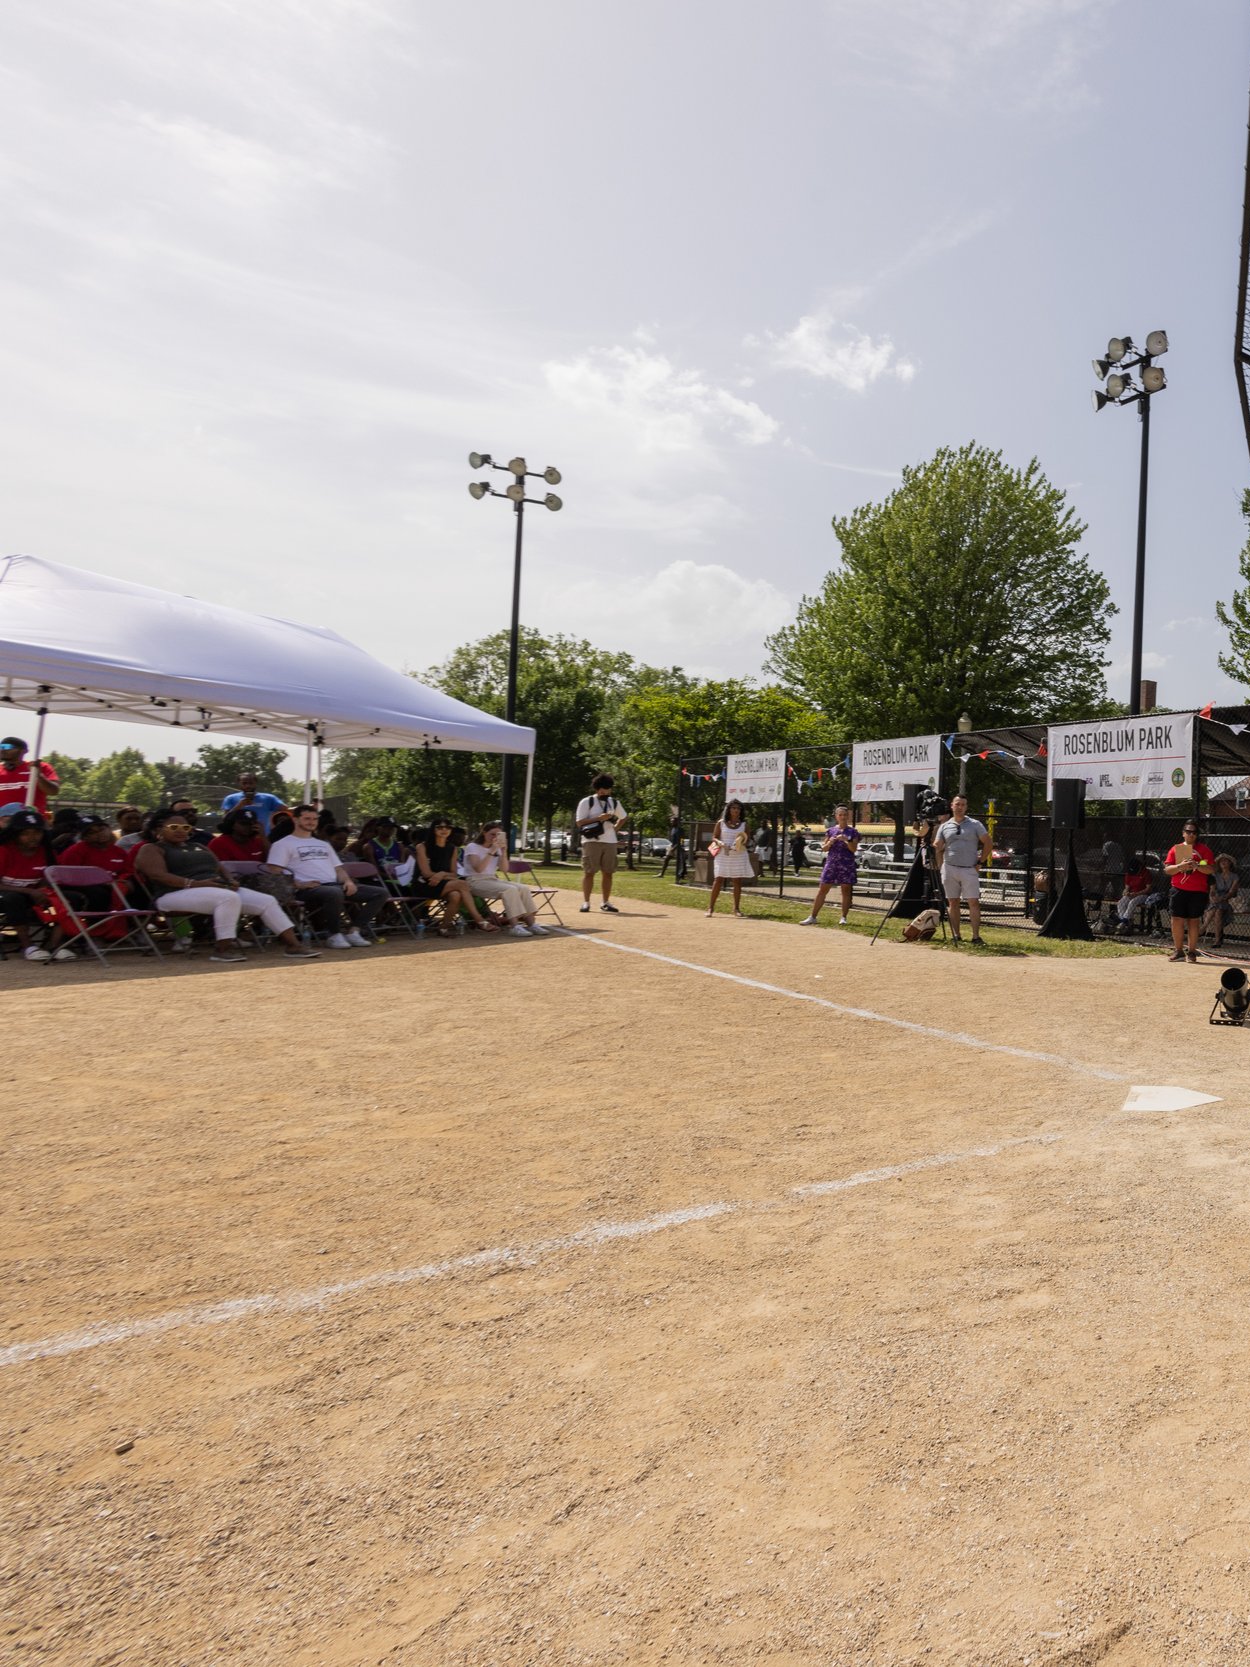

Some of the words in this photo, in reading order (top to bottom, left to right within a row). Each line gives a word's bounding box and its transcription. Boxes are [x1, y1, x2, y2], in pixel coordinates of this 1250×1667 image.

[1064, 729, 1134, 755] ROSENBLUM
[1139, 725, 1172, 750] PARK
[864, 746, 906, 766] ROSENBLUM
[909, 745, 929, 763] PARK
